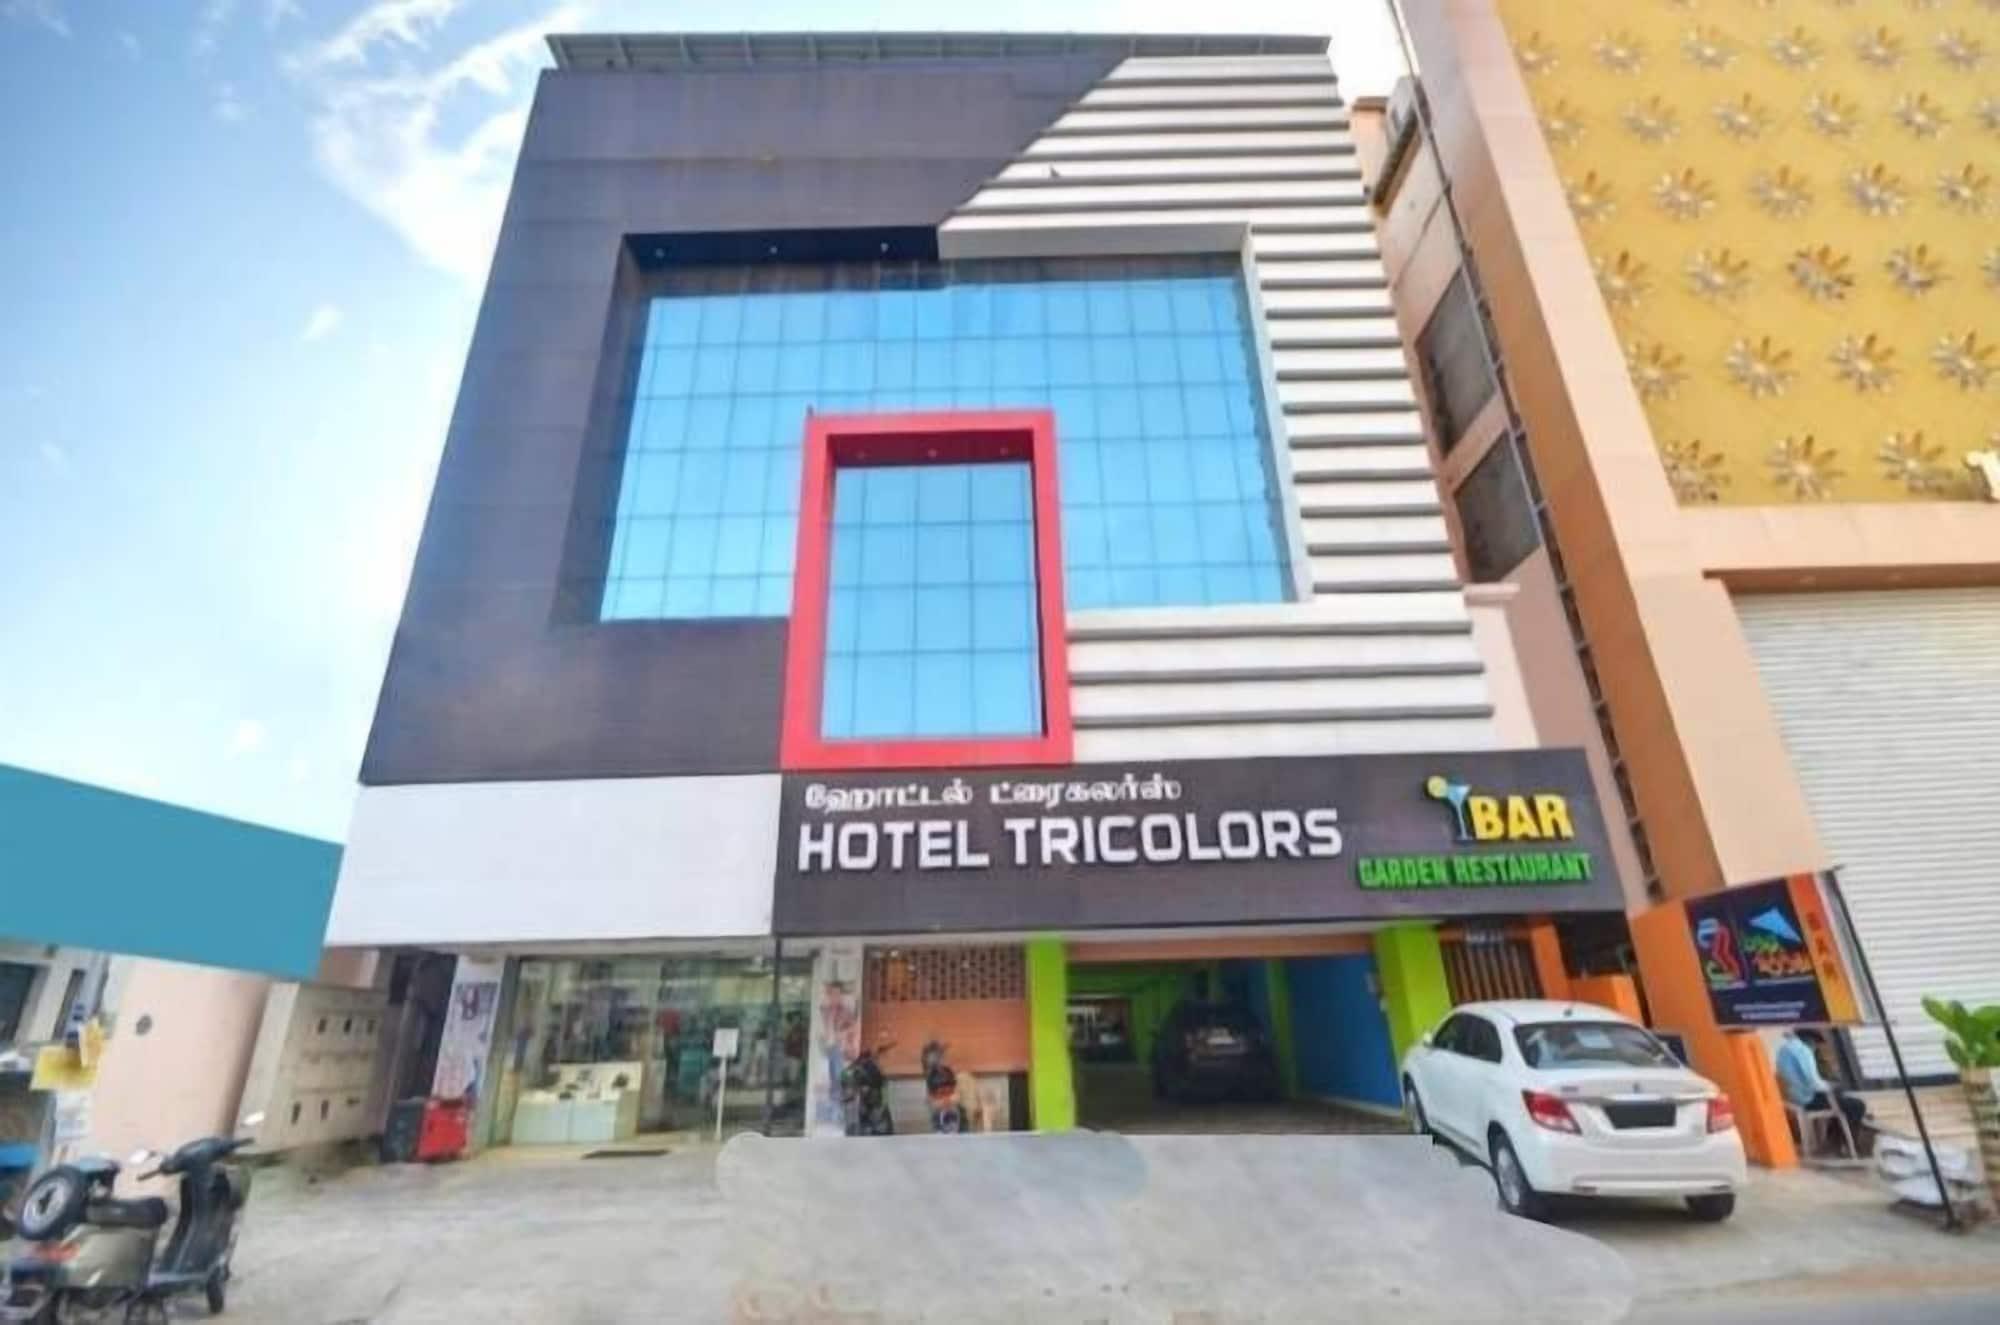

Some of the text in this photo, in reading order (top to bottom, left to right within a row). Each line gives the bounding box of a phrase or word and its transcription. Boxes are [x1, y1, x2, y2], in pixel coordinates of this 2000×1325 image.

[798, 808, 1343, 871] HOTEL TRICOLORS
[1468, 794, 1575, 840] BAR
[1358, 852, 1593, 888] GARDEN RESTAURANT
